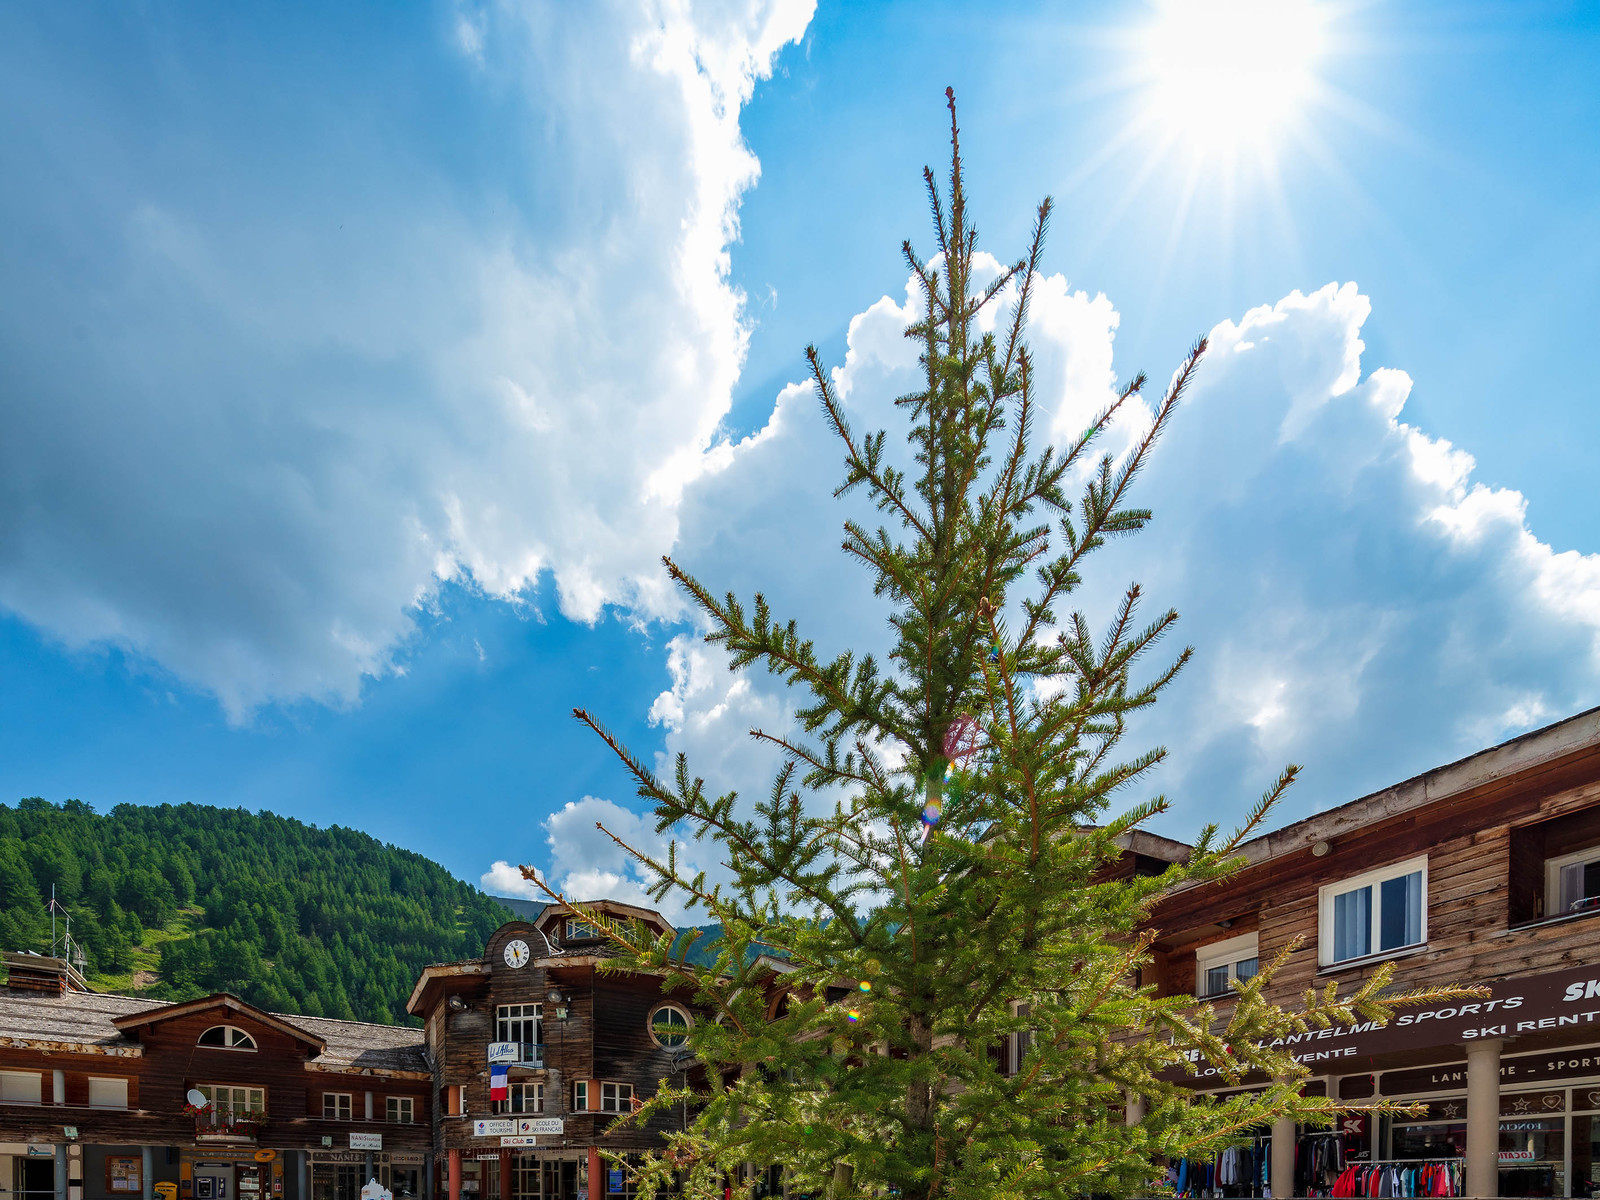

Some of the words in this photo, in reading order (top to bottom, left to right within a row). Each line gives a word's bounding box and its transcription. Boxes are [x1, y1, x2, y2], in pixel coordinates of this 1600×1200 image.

[1257, 1018, 1388, 1050] LANTELME
[1395, 996, 1525, 1027] SPORTS
[1461, 1024, 1506, 1039] SKI
[1290, 1046, 1358, 1064] VENTE
